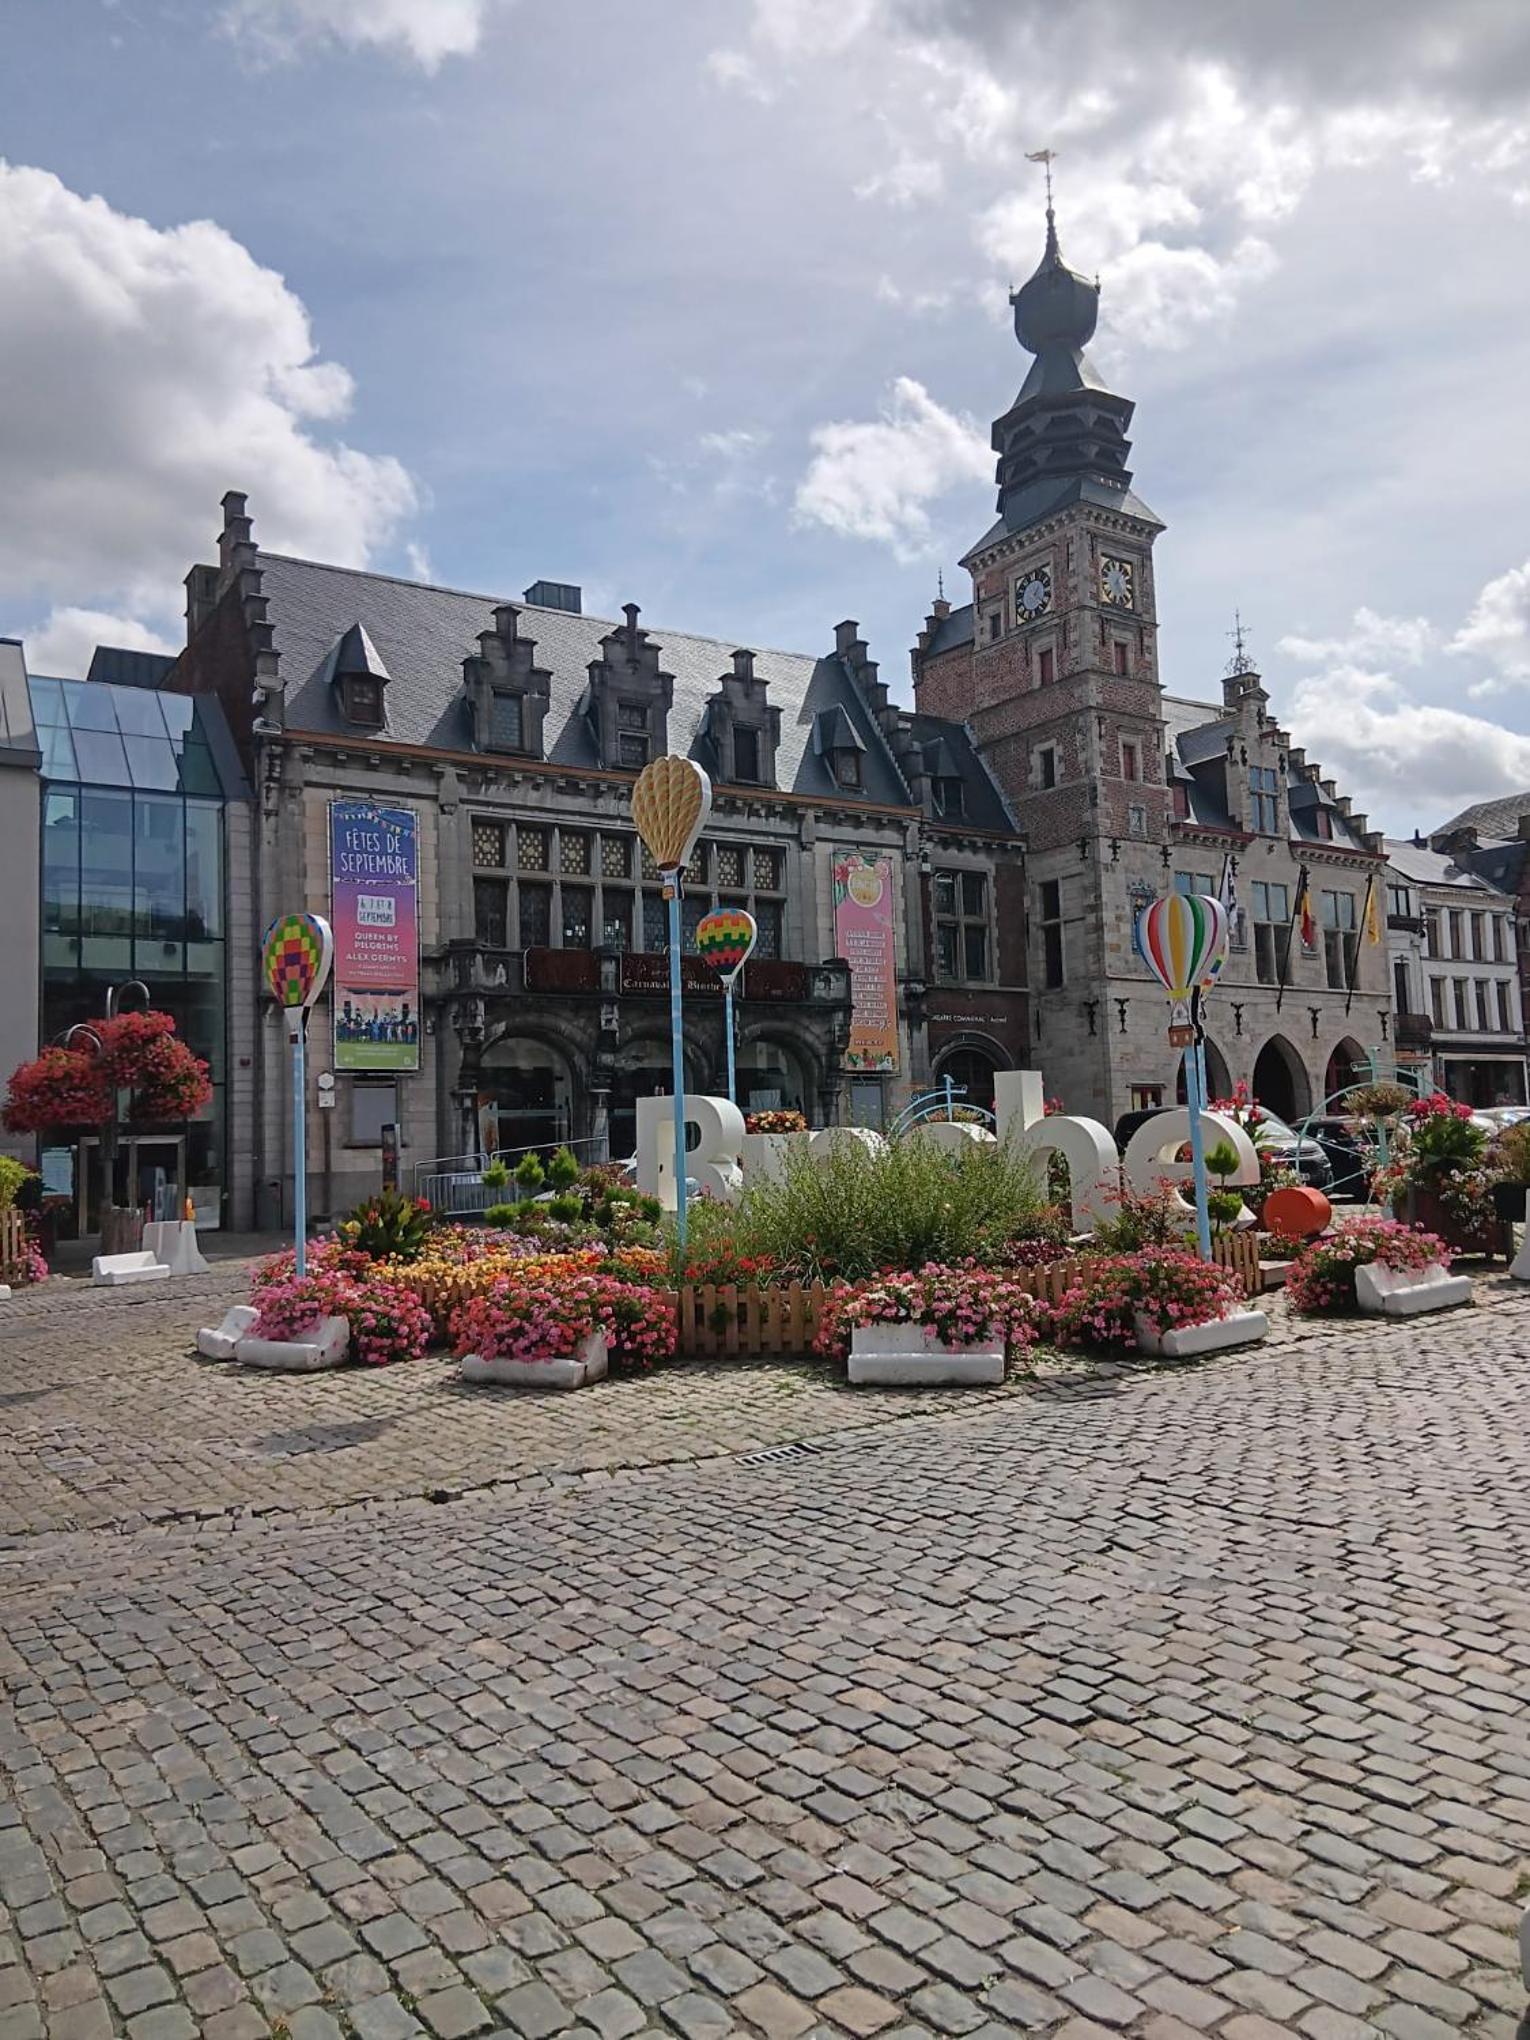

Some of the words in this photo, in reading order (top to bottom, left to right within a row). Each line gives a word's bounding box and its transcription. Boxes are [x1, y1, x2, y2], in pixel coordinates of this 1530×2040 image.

[346, 828, 380, 852] FÊTES
[386, 833, 402, 853] DE
[340, 852, 410, 875] SEPTEMBRE
[354, 932, 386, 941] QUEEN
[387, 934, 399, 942] BY
[354, 940, 399, 951] PILGRIMS
[345, 952, 369, 961] ALEX
[636, 1070, 1262, 1236] Binhe
